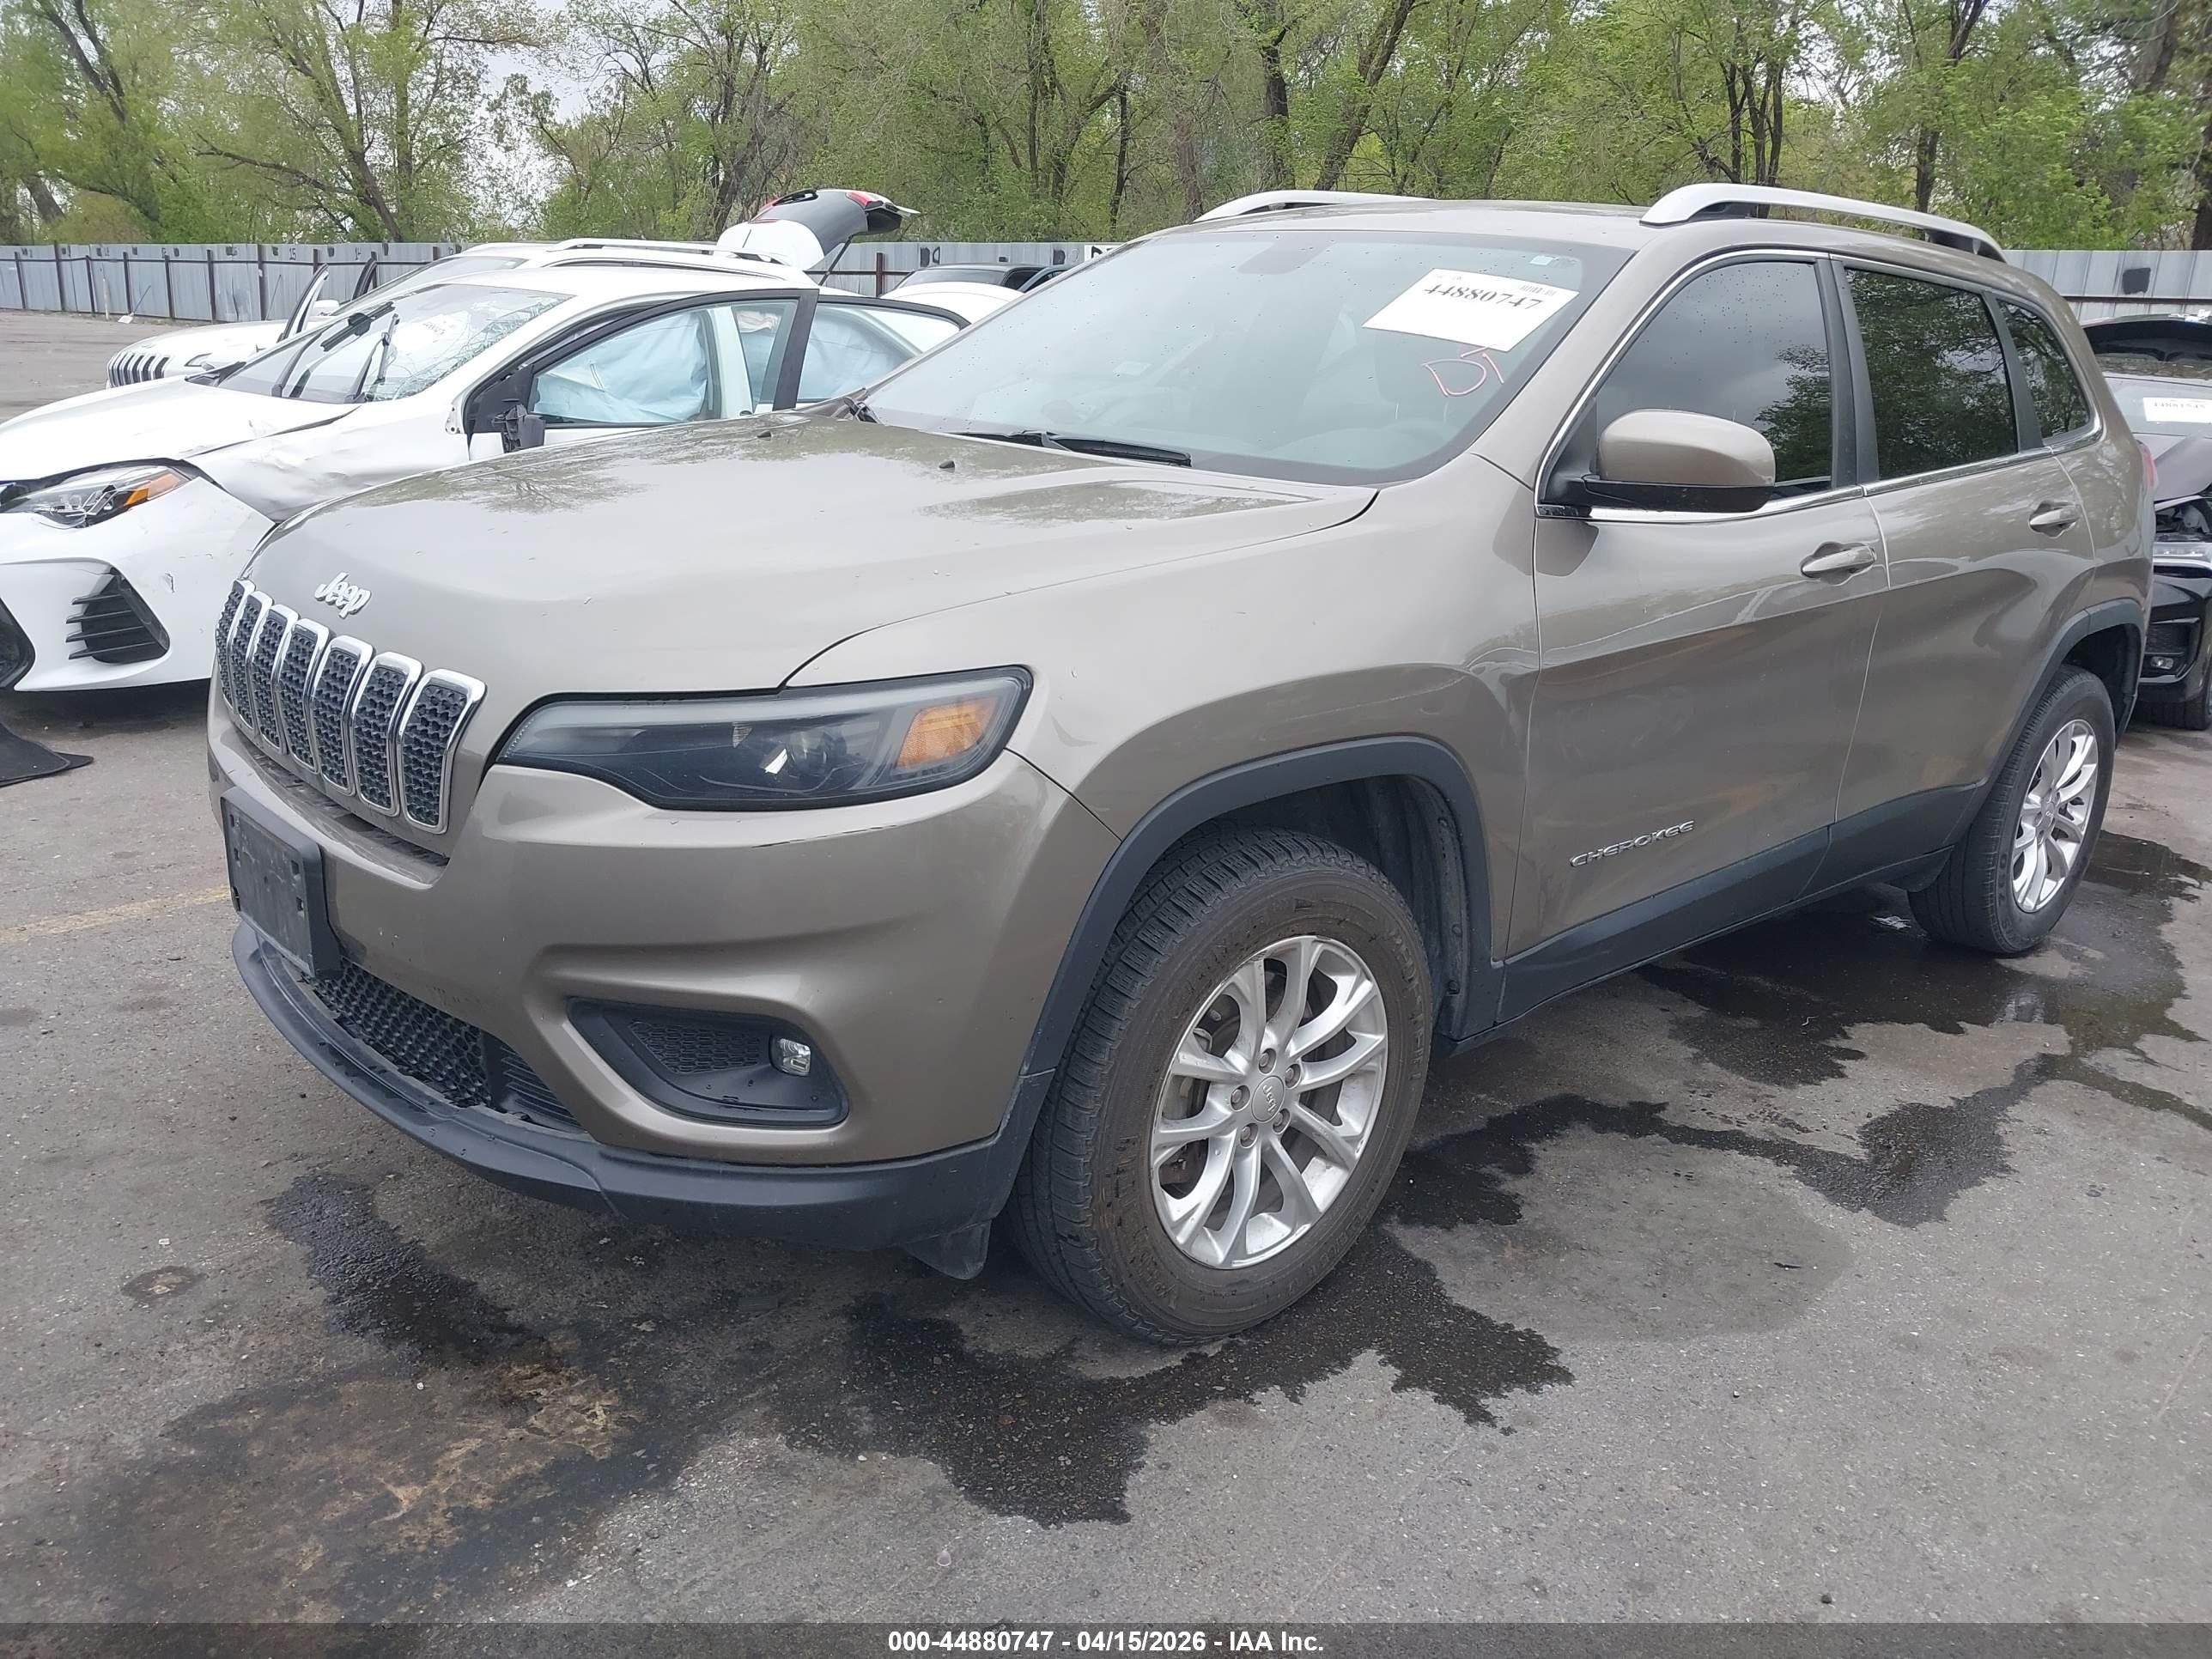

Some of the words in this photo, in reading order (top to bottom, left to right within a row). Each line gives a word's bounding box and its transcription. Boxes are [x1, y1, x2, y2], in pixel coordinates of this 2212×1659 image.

[1424, 283, 1543, 310] 44880747
[313, 572, 372, 620] Jeep
[1570, 819, 1695, 867] CHEROKEE
[1262, 1085, 1278, 1114] Jeep
